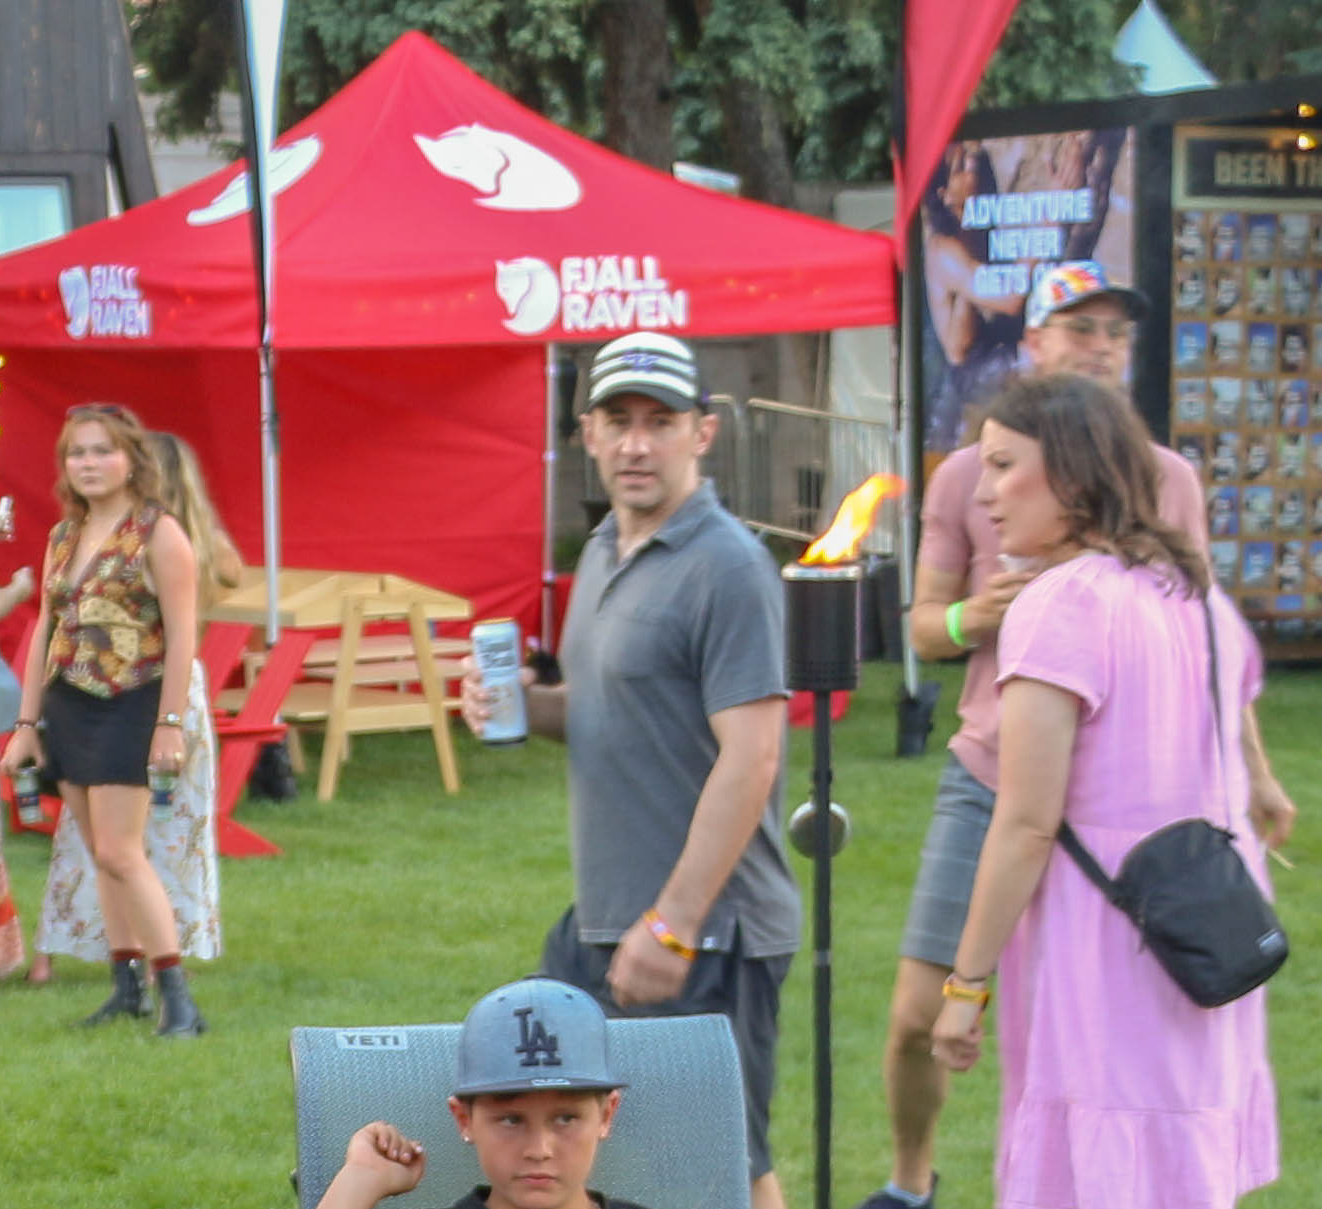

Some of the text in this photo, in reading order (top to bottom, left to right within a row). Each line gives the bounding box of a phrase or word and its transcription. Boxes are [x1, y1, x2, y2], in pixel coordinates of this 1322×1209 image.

[1214, 152, 1286, 186] BEEN
[961, 187, 1094, 231] ADVENTURE
[988, 226, 1064, 262] NEVER
[562, 288, 689, 332] RAVEN
[342, 1033, 401, 1047] YETI
[513, 1007, 562, 1067] LA
